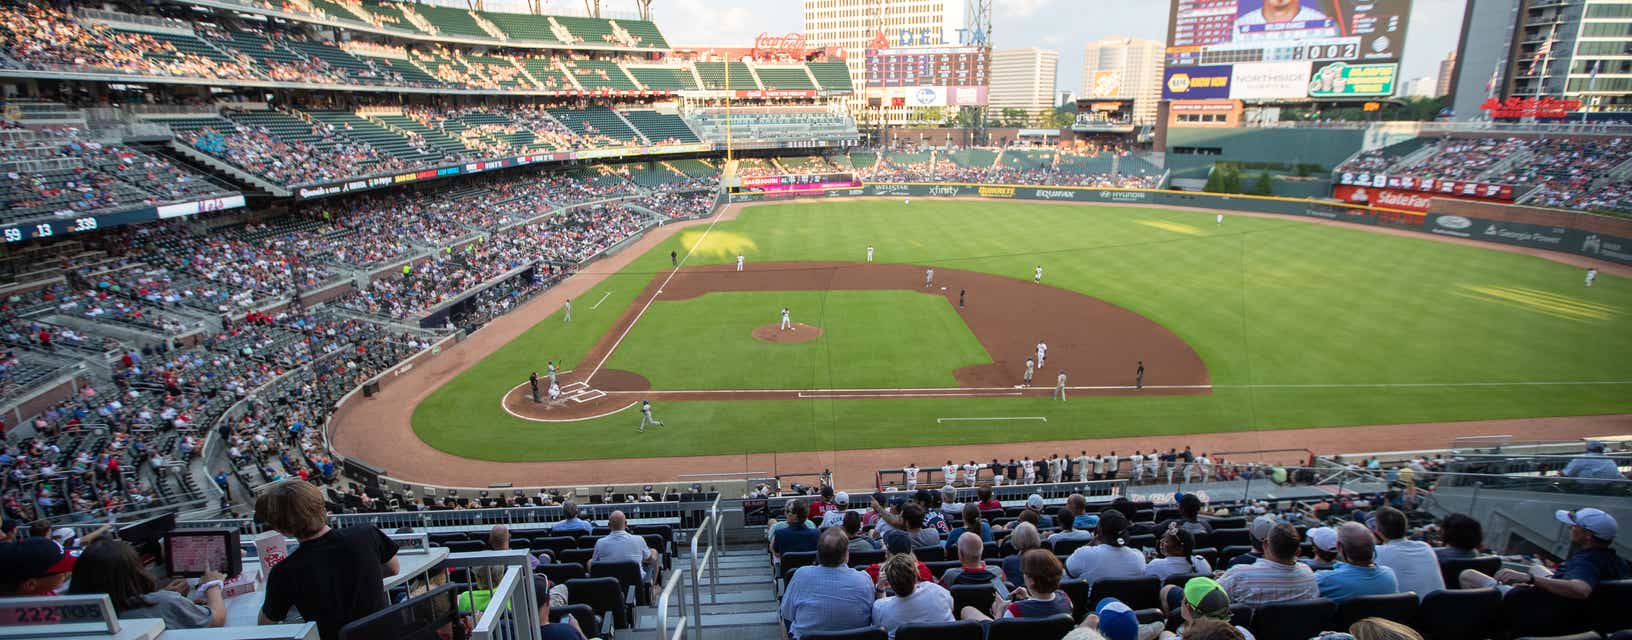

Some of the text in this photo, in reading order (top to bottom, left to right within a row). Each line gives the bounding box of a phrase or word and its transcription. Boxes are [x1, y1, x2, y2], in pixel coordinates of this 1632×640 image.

[899, 27, 986, 45] DELTA
[1309, 46, 1320, 58] 0
[1327, 45, 1338, 58] 0
[1343, 43, 1355, 57] 2
[928, 185, 959, 196] xfinity
[1036, 189, 1075, 199] EQUIFAX
[1111, 191, 1145, 199] HYUNDAI
[4, 216, 98, 242] 59 13 .339
